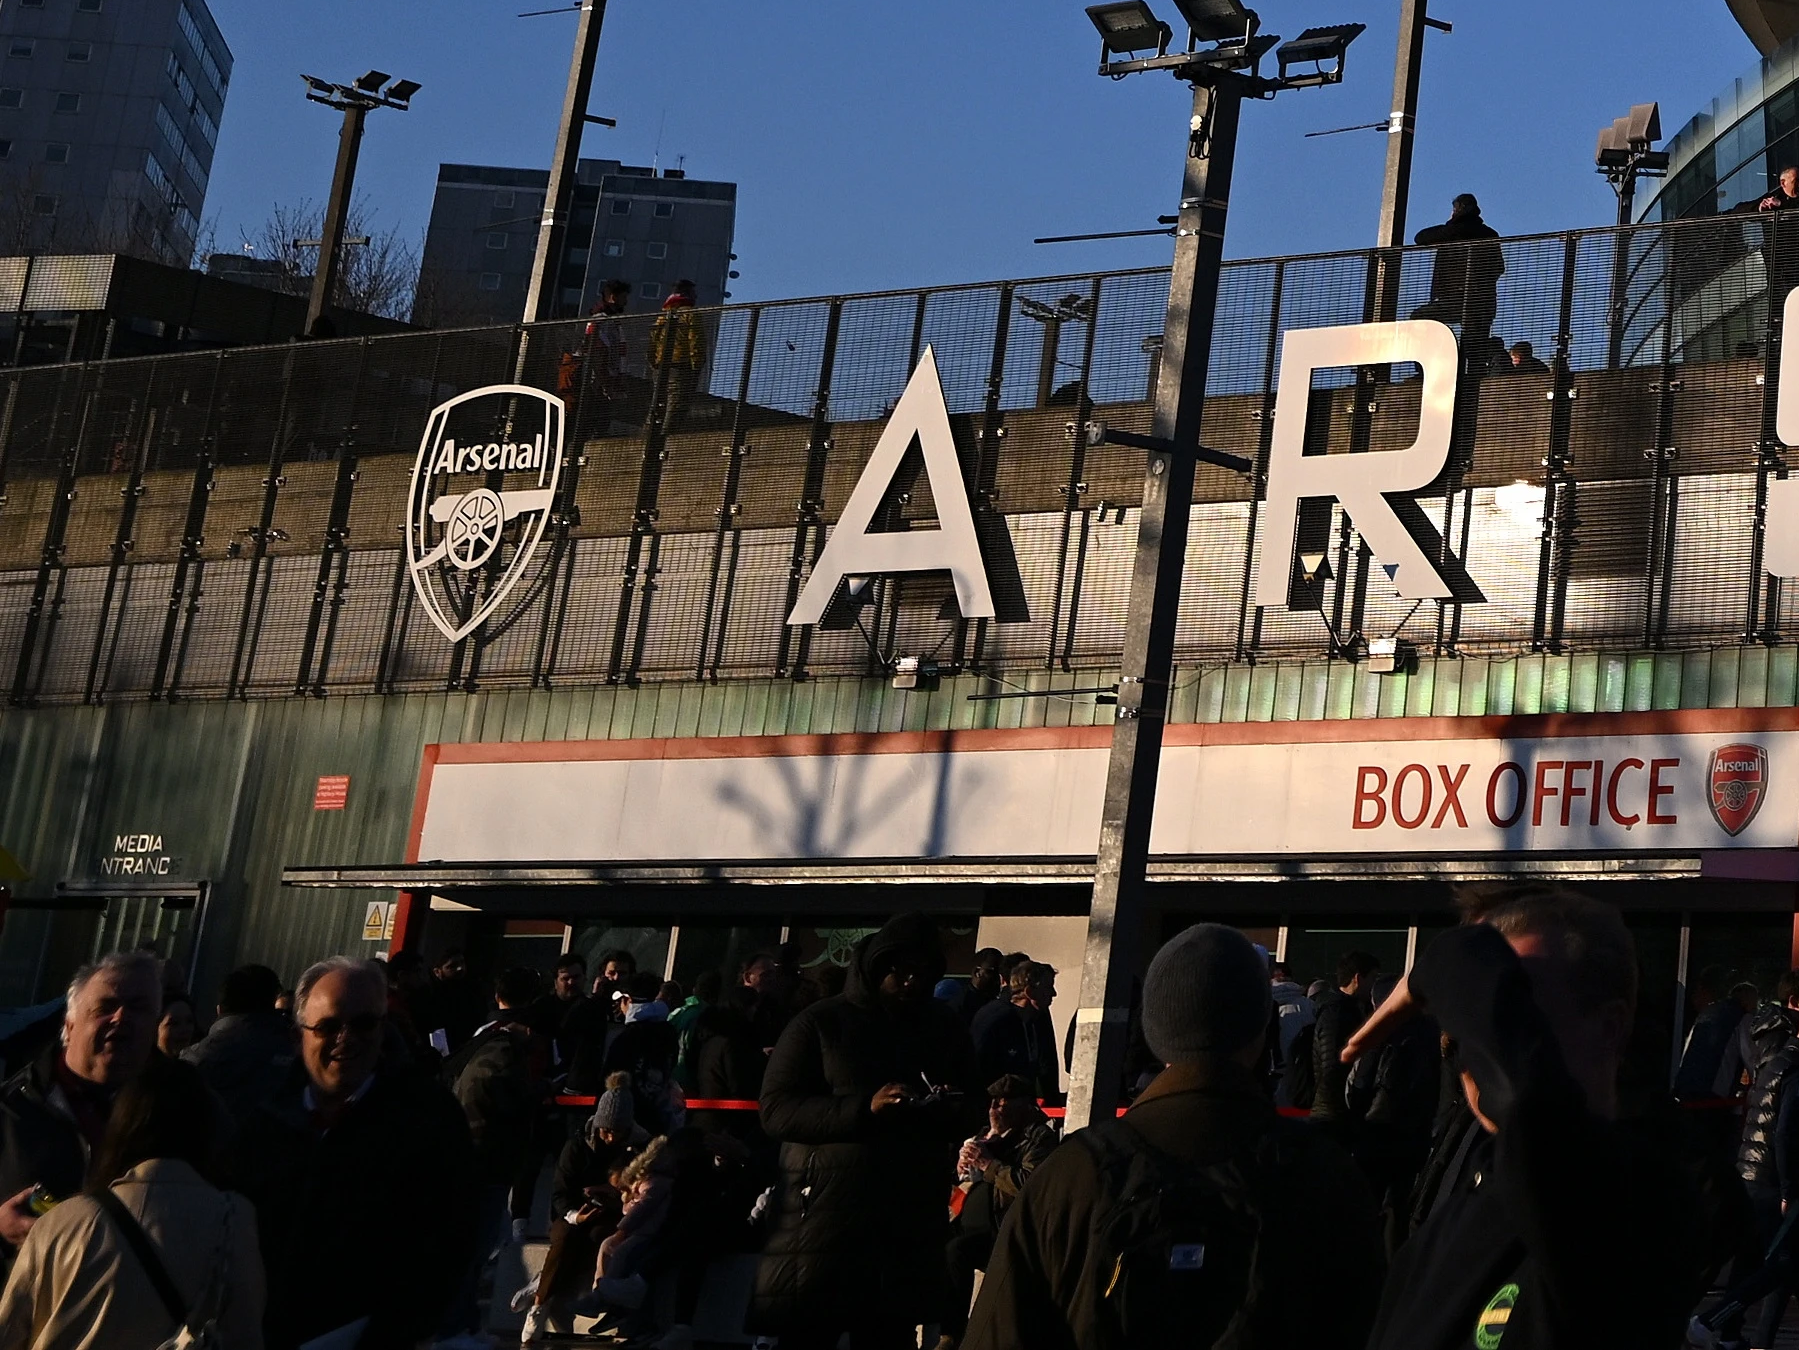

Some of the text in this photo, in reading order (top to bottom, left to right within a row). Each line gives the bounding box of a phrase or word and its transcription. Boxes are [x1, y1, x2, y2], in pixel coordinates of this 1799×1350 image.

[433, 433, 543, 475] Arsenal
[1714, 758, 1760, 775] Arsenal
[1352, 757, 1681, 830] BOX OFFICE
[114, 834, 163, 853] MEDIA
